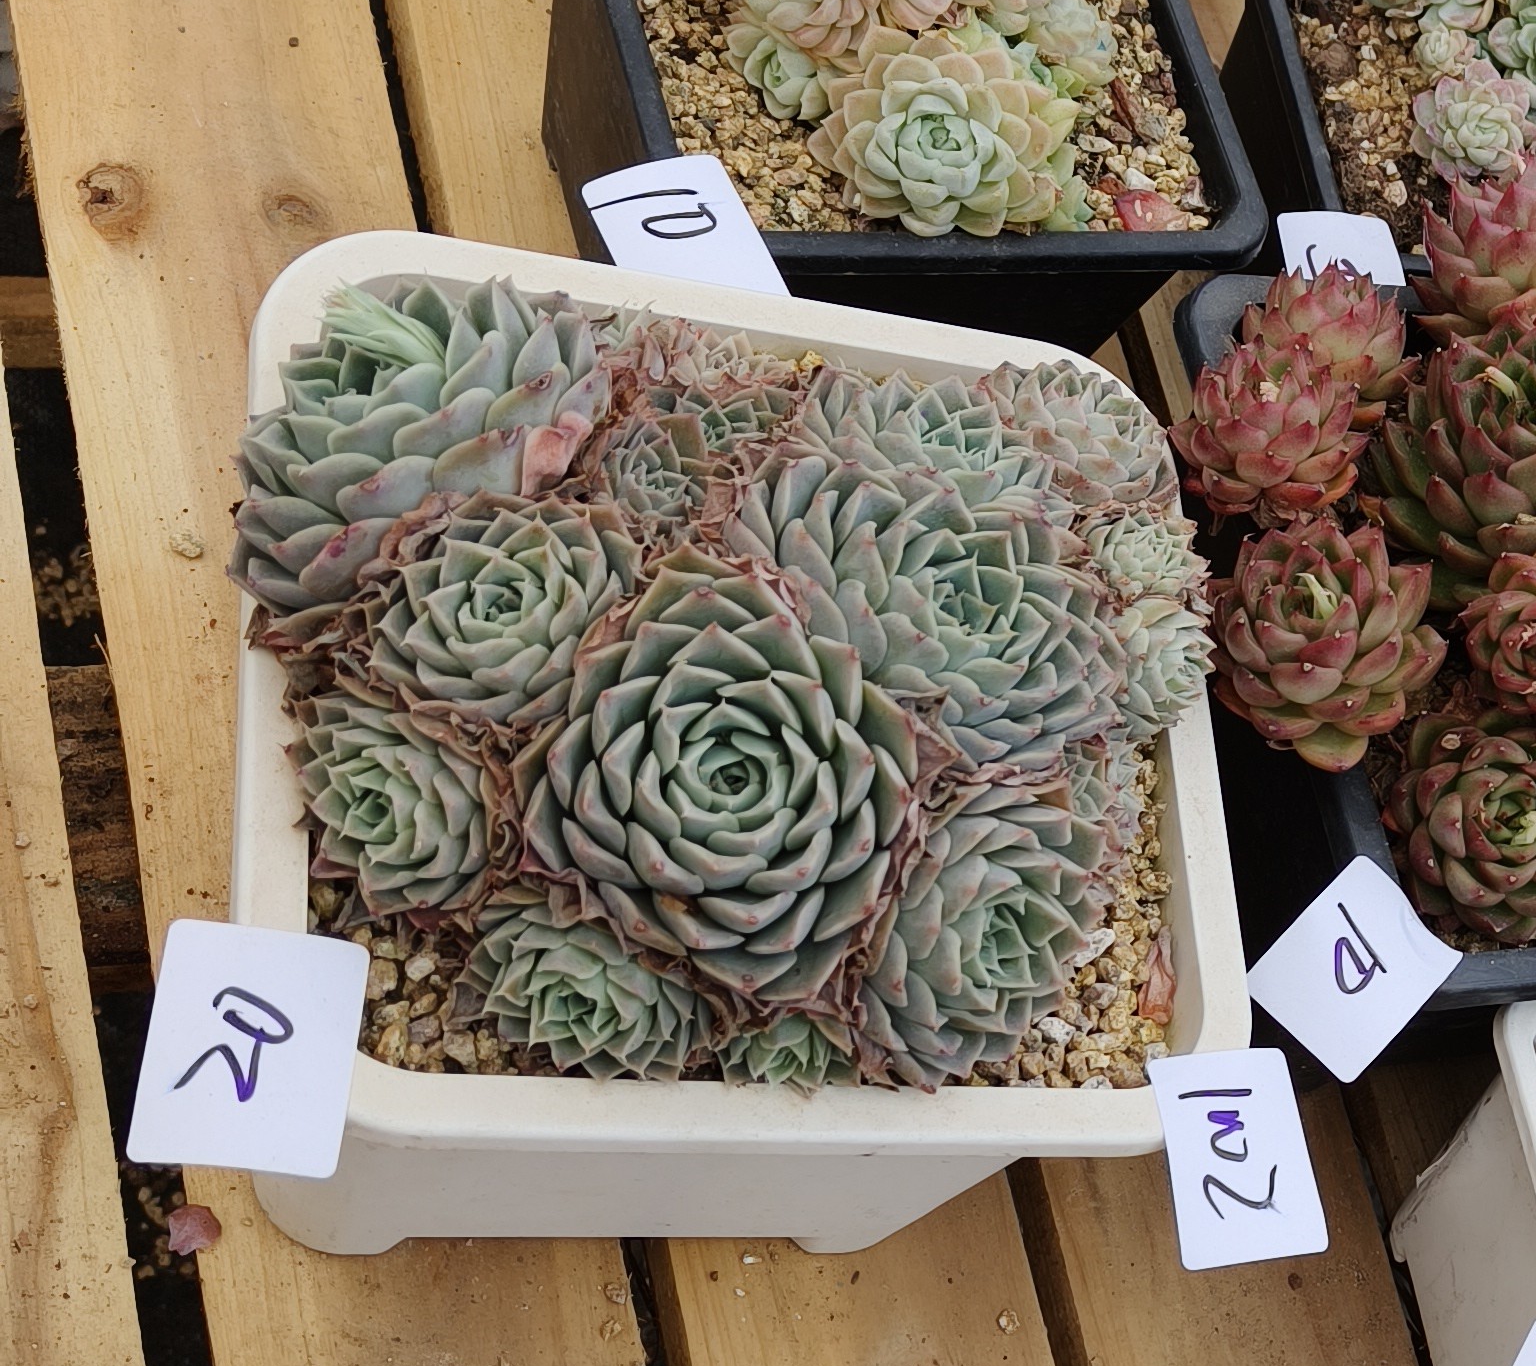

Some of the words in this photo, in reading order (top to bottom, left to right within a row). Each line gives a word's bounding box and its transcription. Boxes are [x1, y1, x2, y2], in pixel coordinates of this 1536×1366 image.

[588, 188, 717, 239] 10
[1335, 902, 1387, 994] 10
[172, 987, 293, 1103] 20
